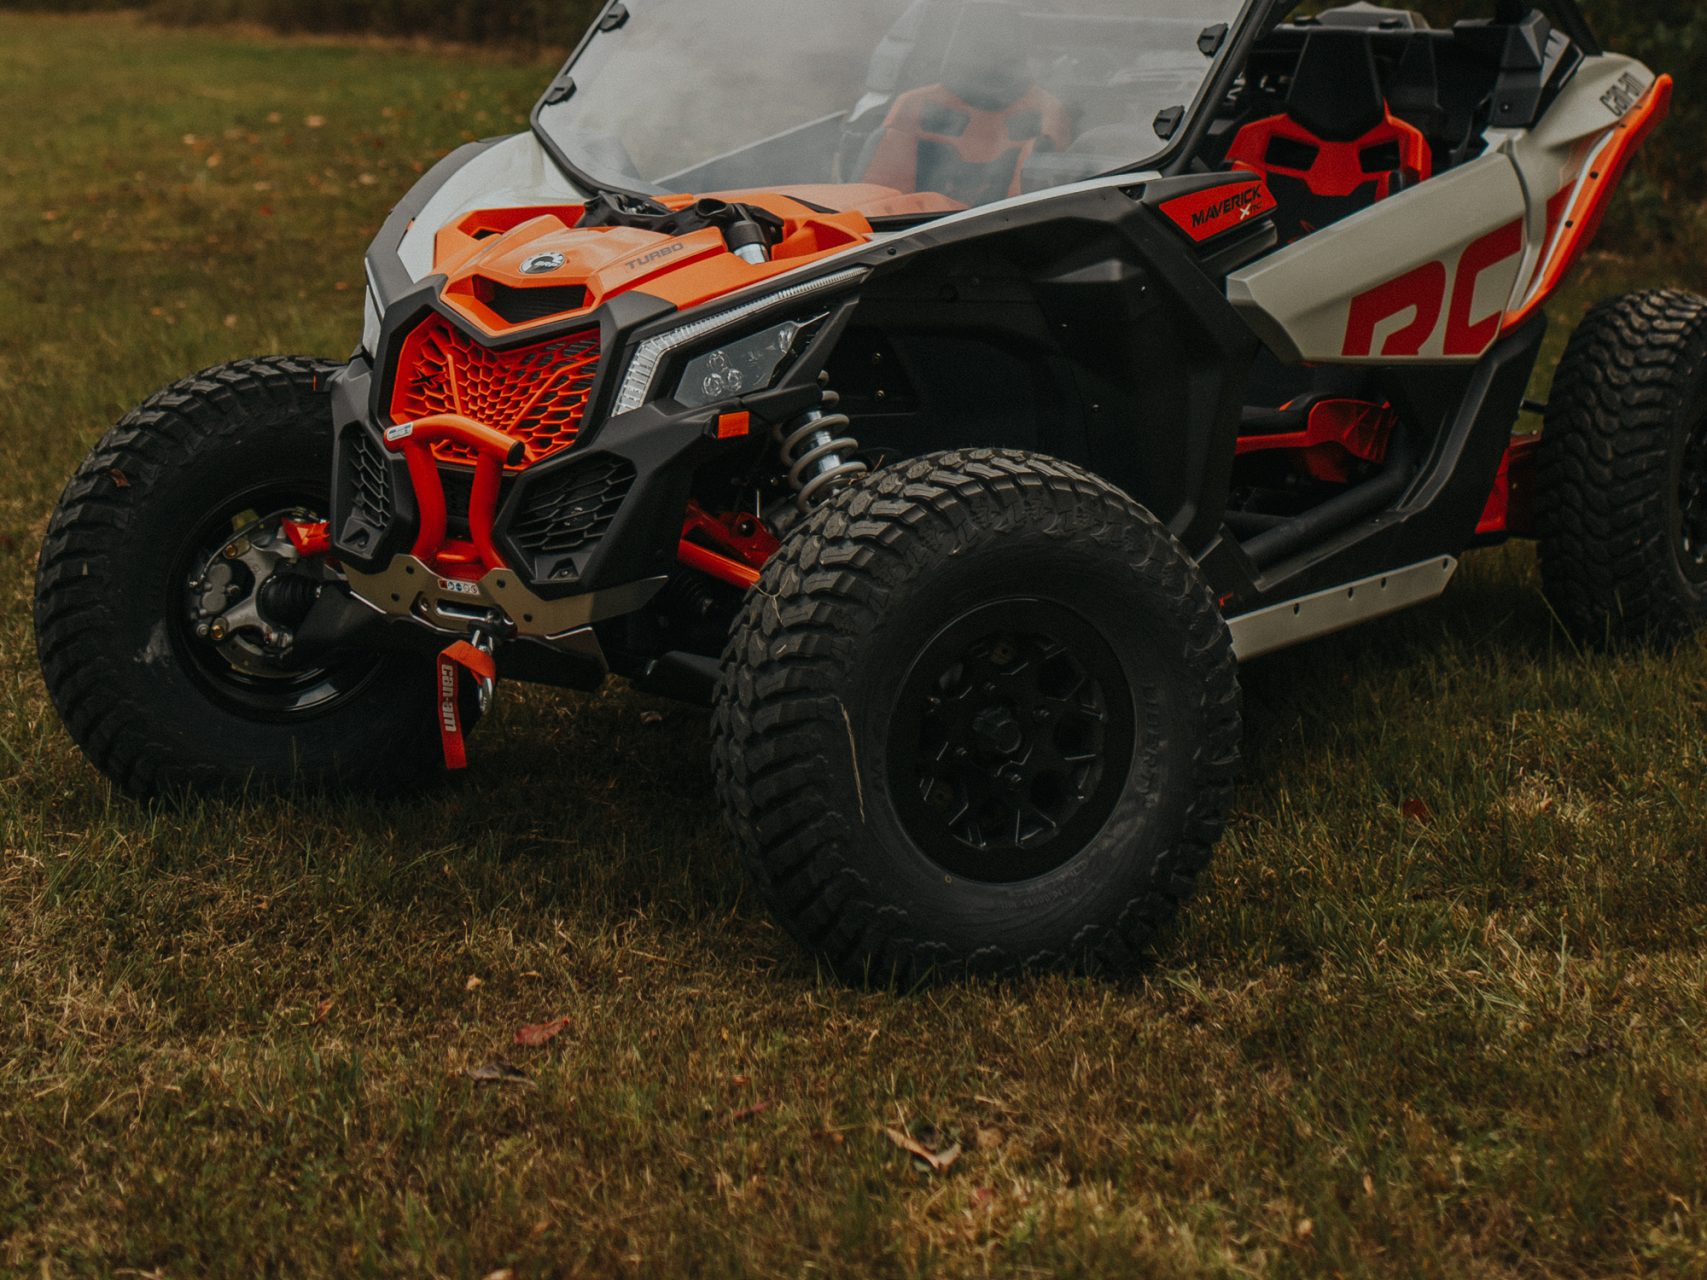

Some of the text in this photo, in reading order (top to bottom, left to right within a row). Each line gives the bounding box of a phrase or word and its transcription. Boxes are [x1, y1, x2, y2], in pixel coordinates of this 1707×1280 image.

[1191, 184, 1262, 227] MAVERICK
[625, 243, 684, 269] TURBO
[1341, 217, 1523, 356] RC
[441, 664, 457, 732] can-am
